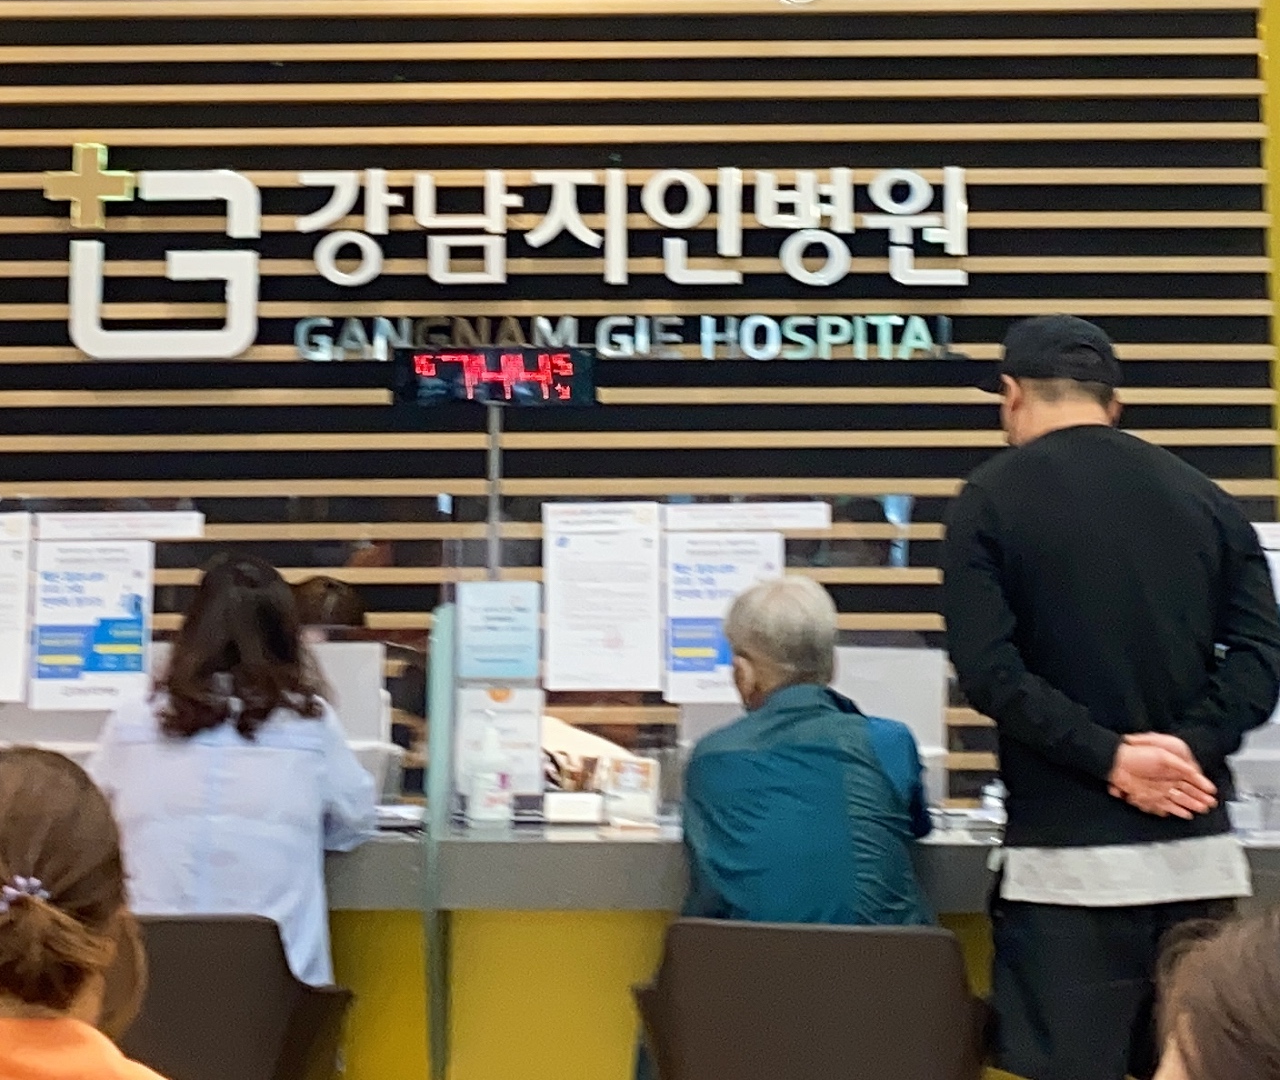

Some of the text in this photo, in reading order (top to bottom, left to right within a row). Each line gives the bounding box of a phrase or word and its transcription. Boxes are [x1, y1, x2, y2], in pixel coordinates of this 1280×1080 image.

[295, 166, 969, 287] 강남지인병원
[294, 316, 579, 362] GANGNAM
[594, 316, 686, 360] GIE
